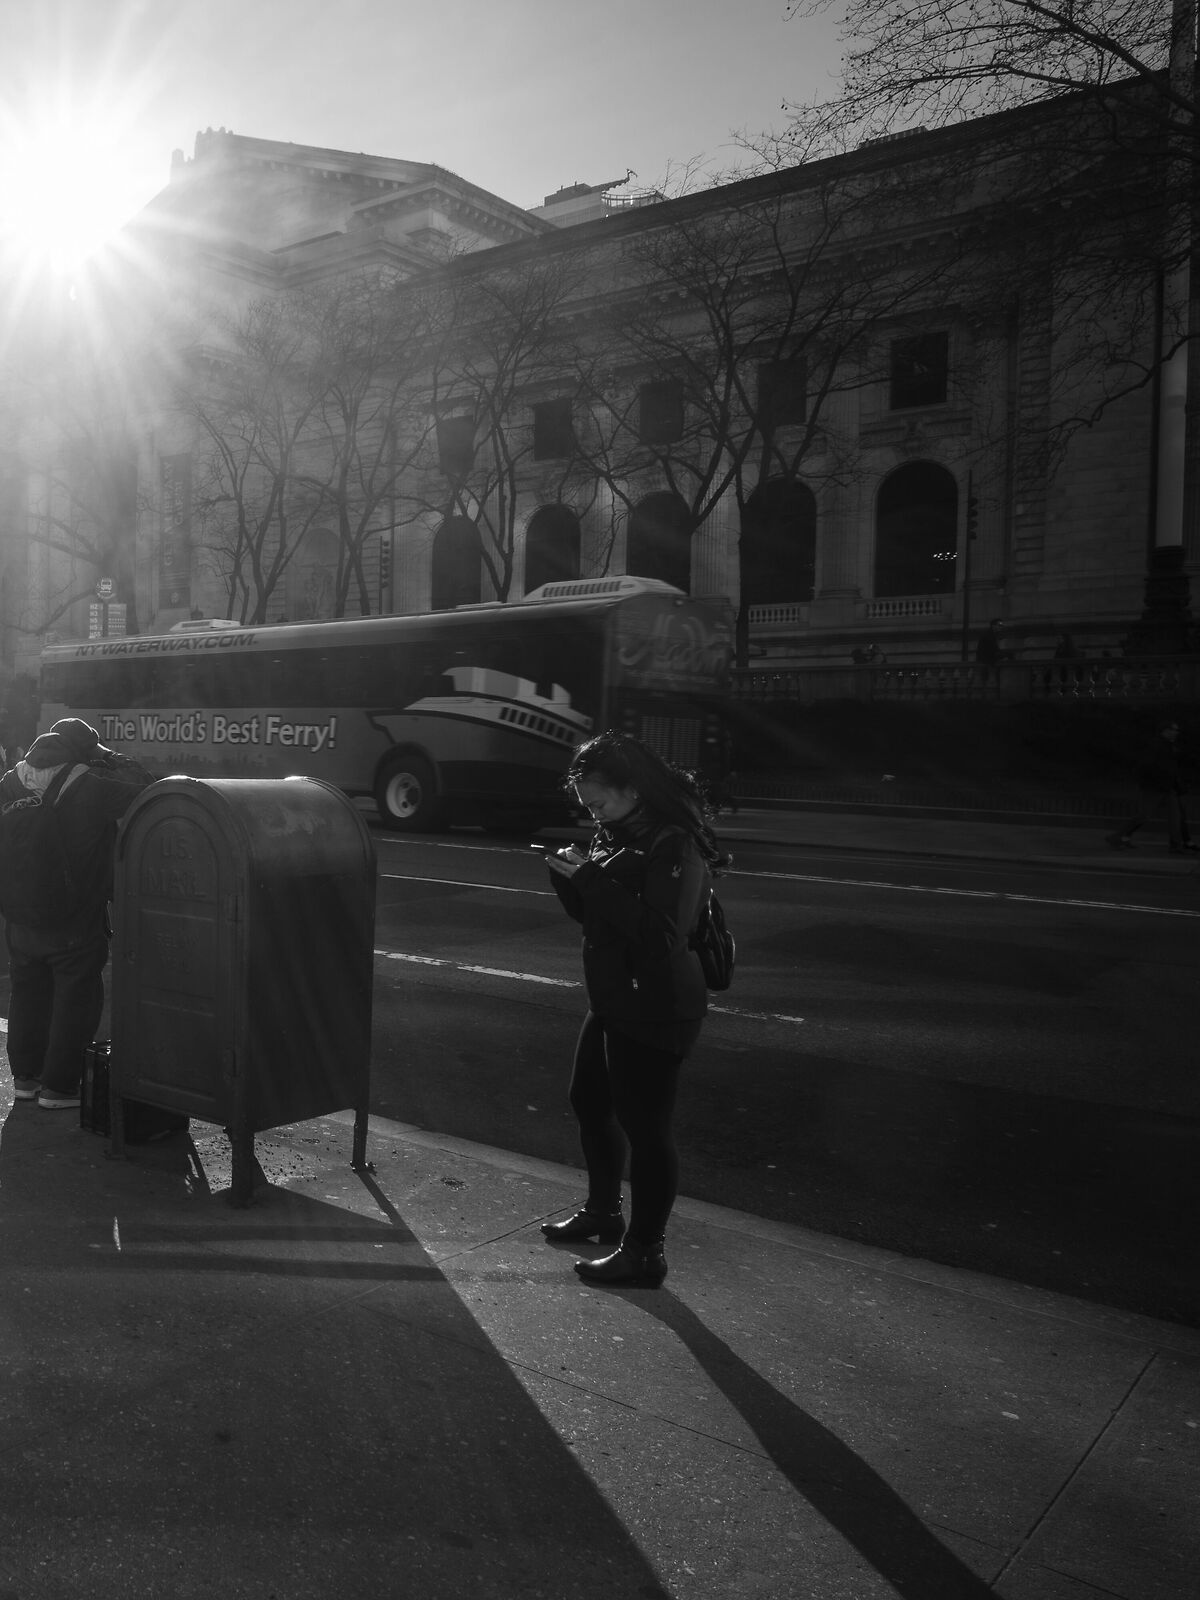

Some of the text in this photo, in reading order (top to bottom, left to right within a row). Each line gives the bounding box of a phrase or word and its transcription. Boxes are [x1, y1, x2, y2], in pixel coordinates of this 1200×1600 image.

[102, 712, 337, 752] The World's Best Ferry!
[143, 867, 208, 898] MAIL
